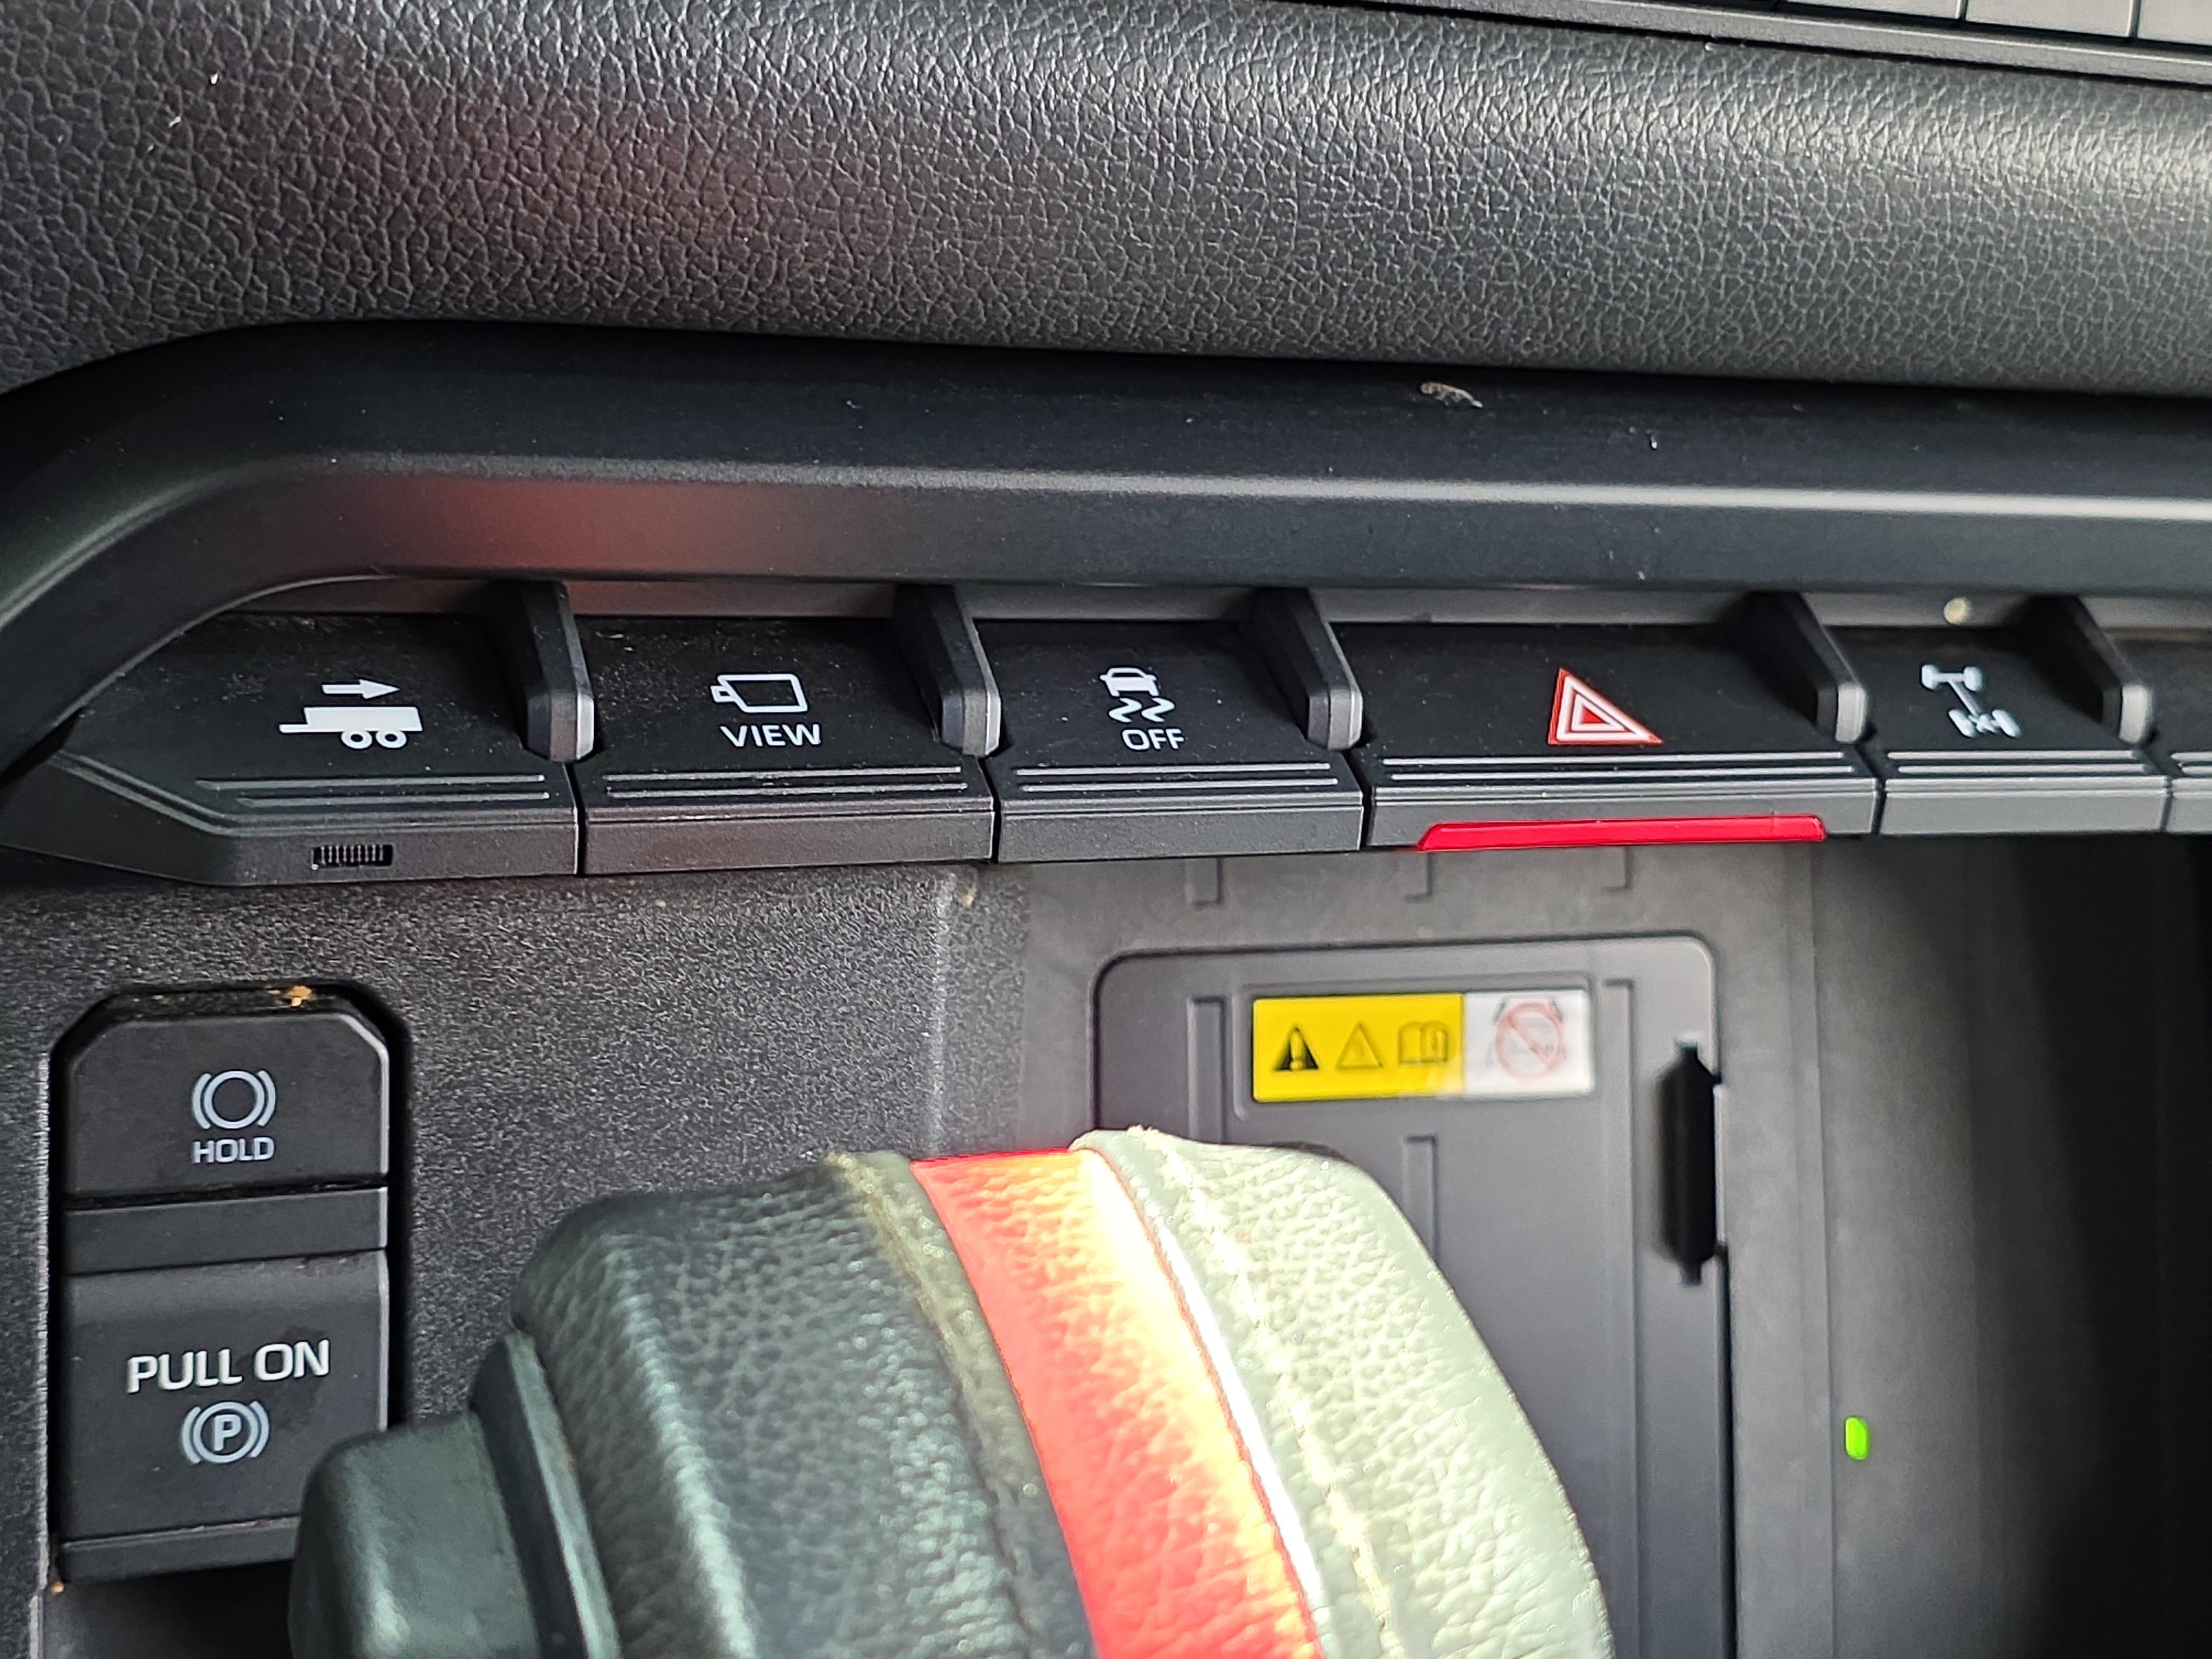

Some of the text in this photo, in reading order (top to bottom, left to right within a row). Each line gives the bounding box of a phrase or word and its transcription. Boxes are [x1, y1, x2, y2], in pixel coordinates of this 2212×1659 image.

[720, 724, 821, 747] VIEW
[1122, 729, 1185, 750] OFF
[192, 1137, 274, 1163] HOLD
[126, 1339, 330, 1393] PULL ON
[213, 1414, 242, 1451] P
